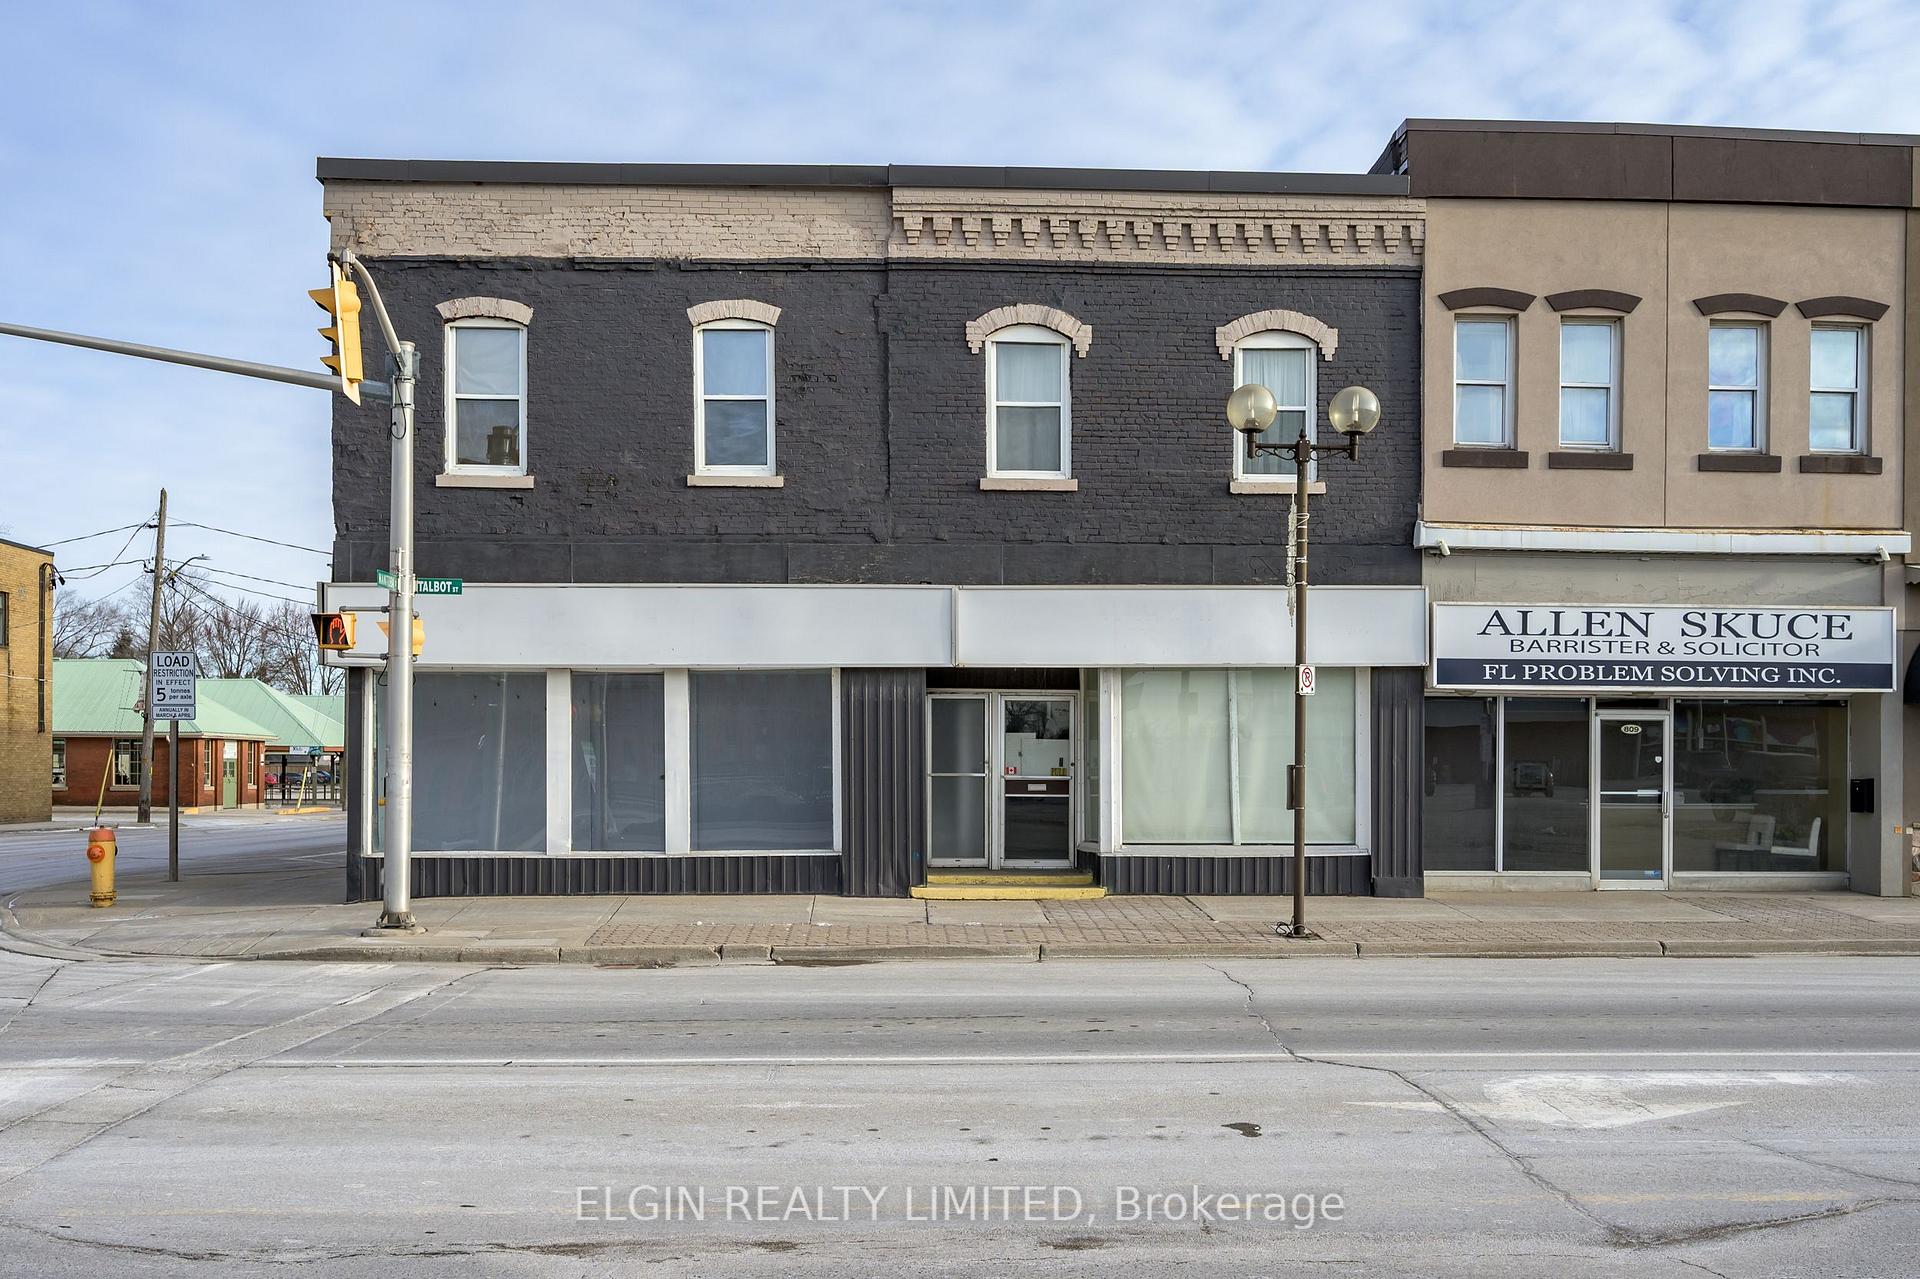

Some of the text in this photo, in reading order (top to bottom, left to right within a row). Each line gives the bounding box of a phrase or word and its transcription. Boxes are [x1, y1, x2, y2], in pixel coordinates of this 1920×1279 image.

[418, 581, 452, 592] TALBOT
[1476, 609, 1853, 640] ALLEN SKUCE
[1510, 639, 1820, 657] BARRISTER & SOLICITOR
[157, 656, 190, 667] LOAD
[153, 669, 194, 677] RESTRICTION
[1482, 664, 1841, 684] FL PROBLEM SOLVING INC.
[157, 687, 166, 701] 5
